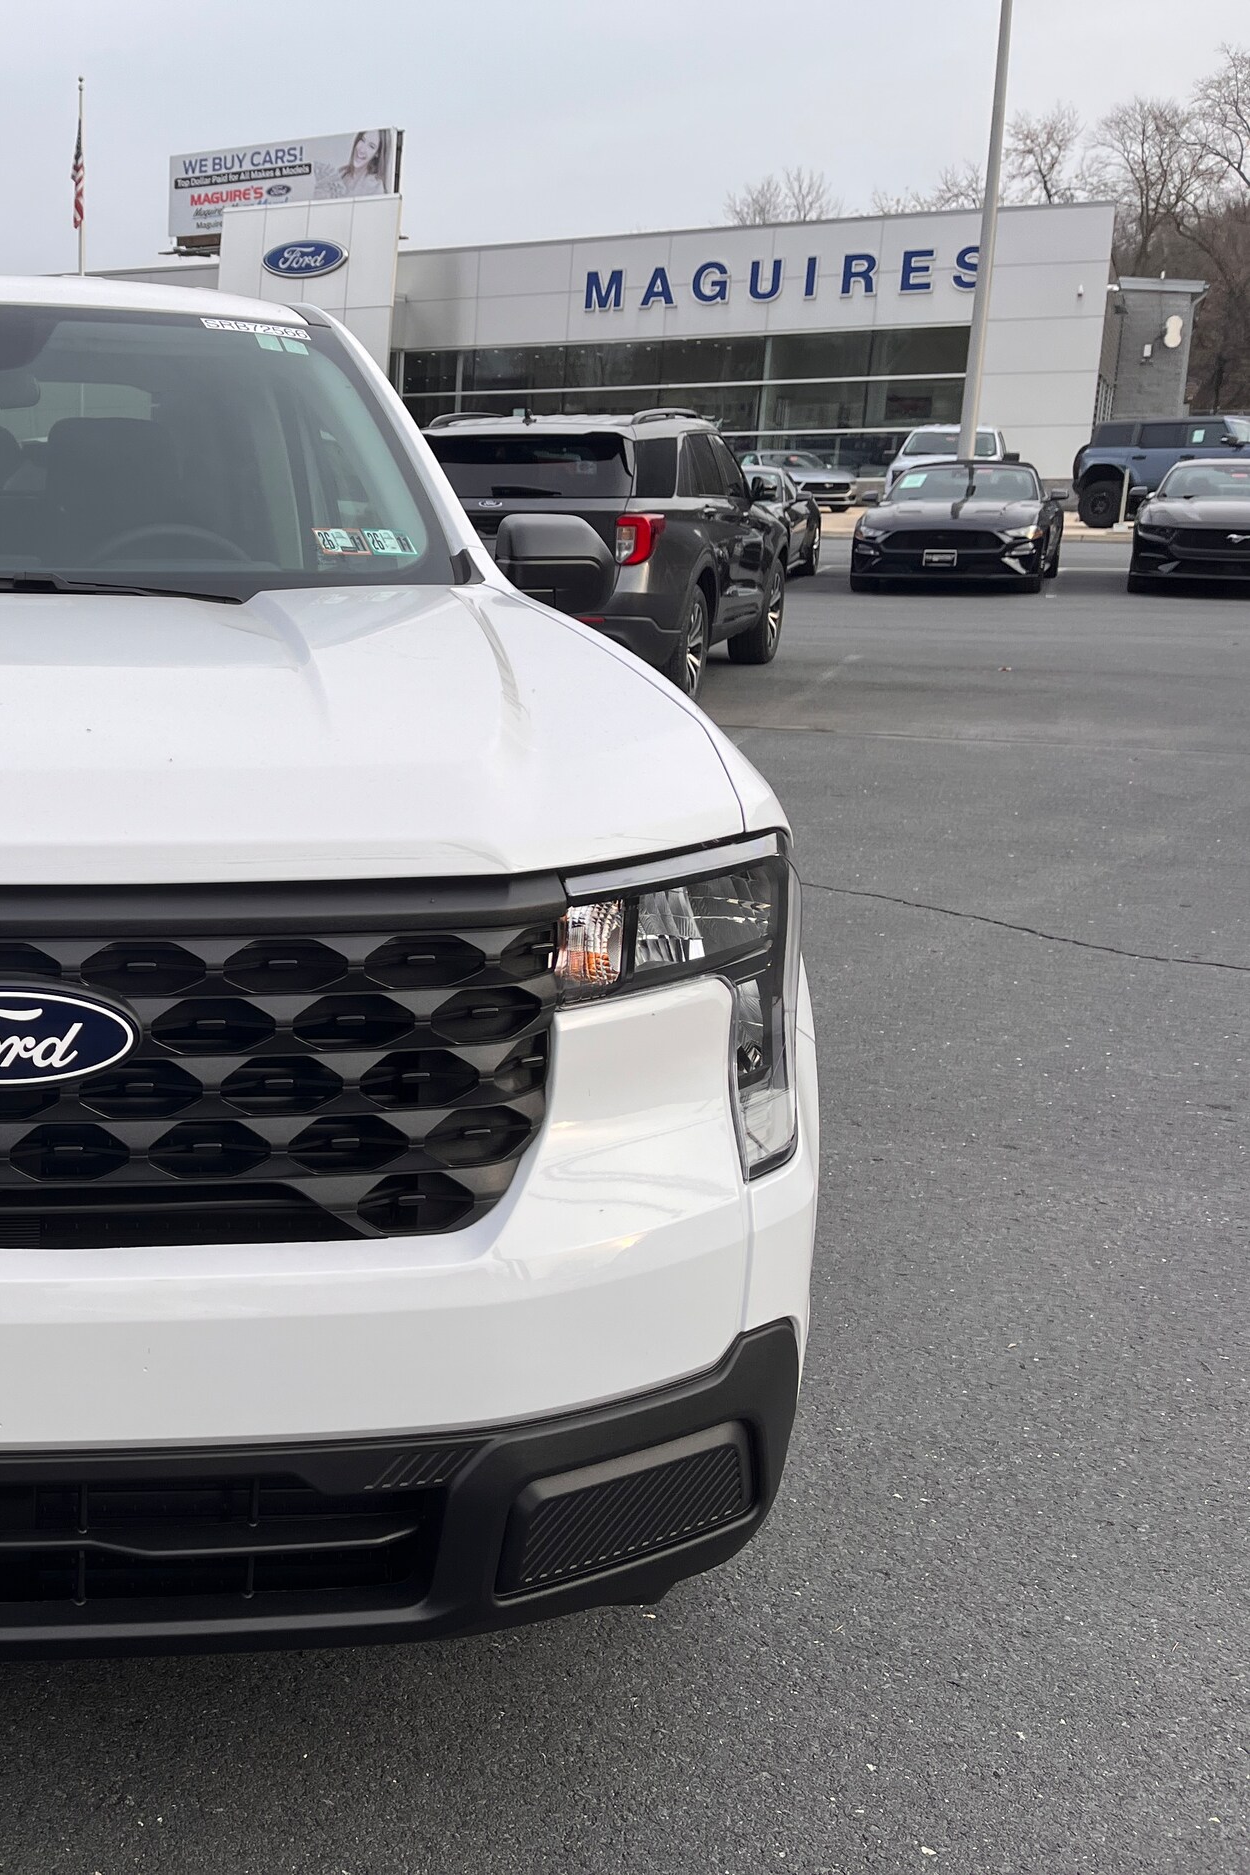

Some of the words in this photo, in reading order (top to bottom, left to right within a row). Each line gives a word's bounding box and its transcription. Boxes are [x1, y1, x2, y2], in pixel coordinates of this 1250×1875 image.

[183, 158, 208, 175] WE
[212, 152, 247, 172] BUY
[250, 146, 304, 167] CARS!
[176, 179, 191, 187] Top
[191, 176, 212, 187] Dollar
[212, 174, 228, 184] Paid
[229, 172, 239, 182] for
[240, 170, 250, 180] All
[250, 168, 275, 180] Makes
[275, 167, 282, 176] &
[282, 164, 310, 176] Models
[190, 185, 264, 206] MAGUIRE'S
[278, 246, 327, 269] Ford
[584, 245, 980, 312] MAGUIRES
[203, 320, 309, 339] SRB72566
[317, 531, 336, 550] 26
[350, 535, 366, 551] 11
[366, 532, 385, 550] 26
[396, 536, 412, 552] 11
